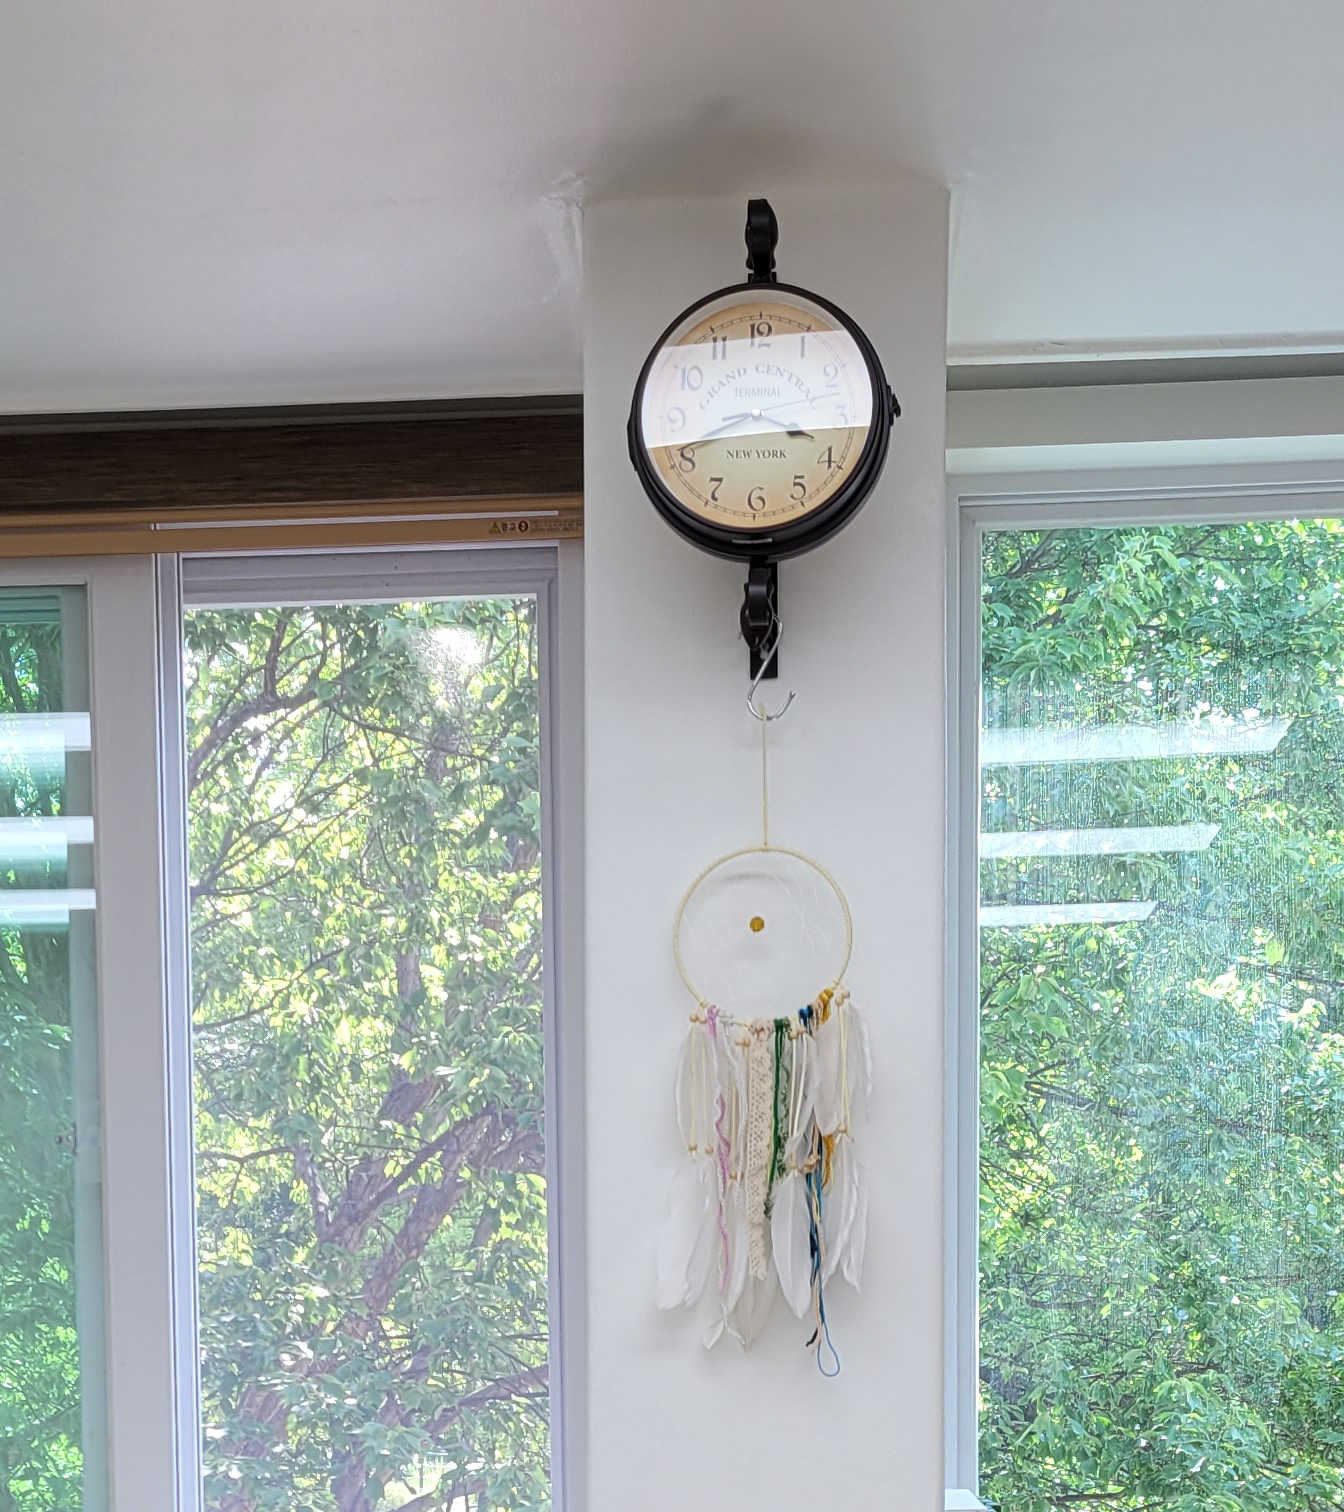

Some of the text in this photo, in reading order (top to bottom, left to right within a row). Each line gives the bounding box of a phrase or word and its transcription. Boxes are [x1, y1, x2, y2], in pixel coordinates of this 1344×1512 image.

[749, 322, 773, 348] 12
[712, 336, 727, 360] 11
[800, 336, 806, 359] 1
[681, 366, 703, 391] 10
[700, 364, 816, 410] GRAND CENTRAL
[823, 364, 839, 388] 2
[734, 387, 782, 398] TERMINAL
[667, 406, 686, 432] 9
[833, 405, 848, 429] 3
[678, 448, 696, 473] 8
[726, 449, 787, 459] NEW YORK
[817, 446, 837, 470] 4
[709, 477, 724, 502] 7
[747, 487, 766, 511] 6
[789, 475, 807, 501] 5
